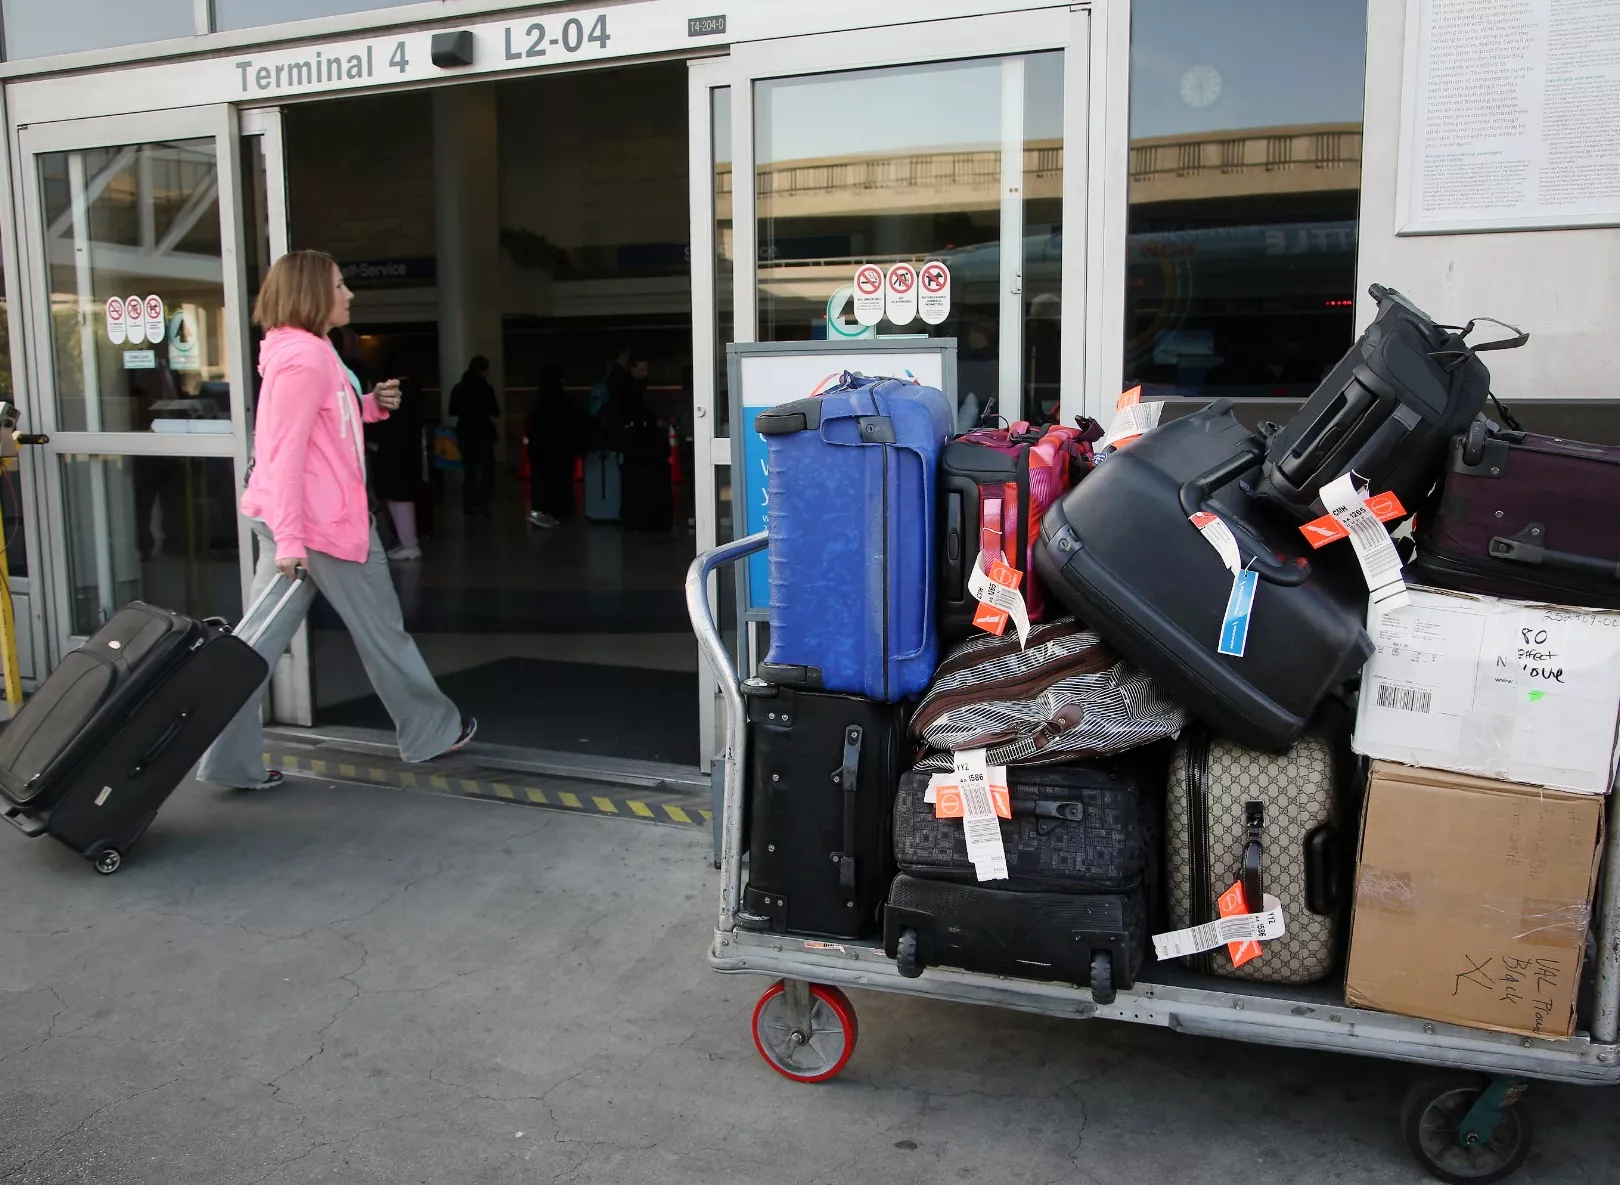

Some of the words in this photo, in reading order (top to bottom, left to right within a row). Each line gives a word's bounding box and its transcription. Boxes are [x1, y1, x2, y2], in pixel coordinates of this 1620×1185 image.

[505, 14, 610, 61] L2-04
[690, 17, 724, 33] T4-204-D
[235, 45, 373, 93] Terminal
[389, 41, 409, 74] 4
[956, 763, 969, 771] YYZ
[969, 774, 984, 782] 1586
[1267, 912, 1276, 924] YYZ
[1452, 954, 1496, 996] XL
[1500, 956, 1533, 1004] Black
